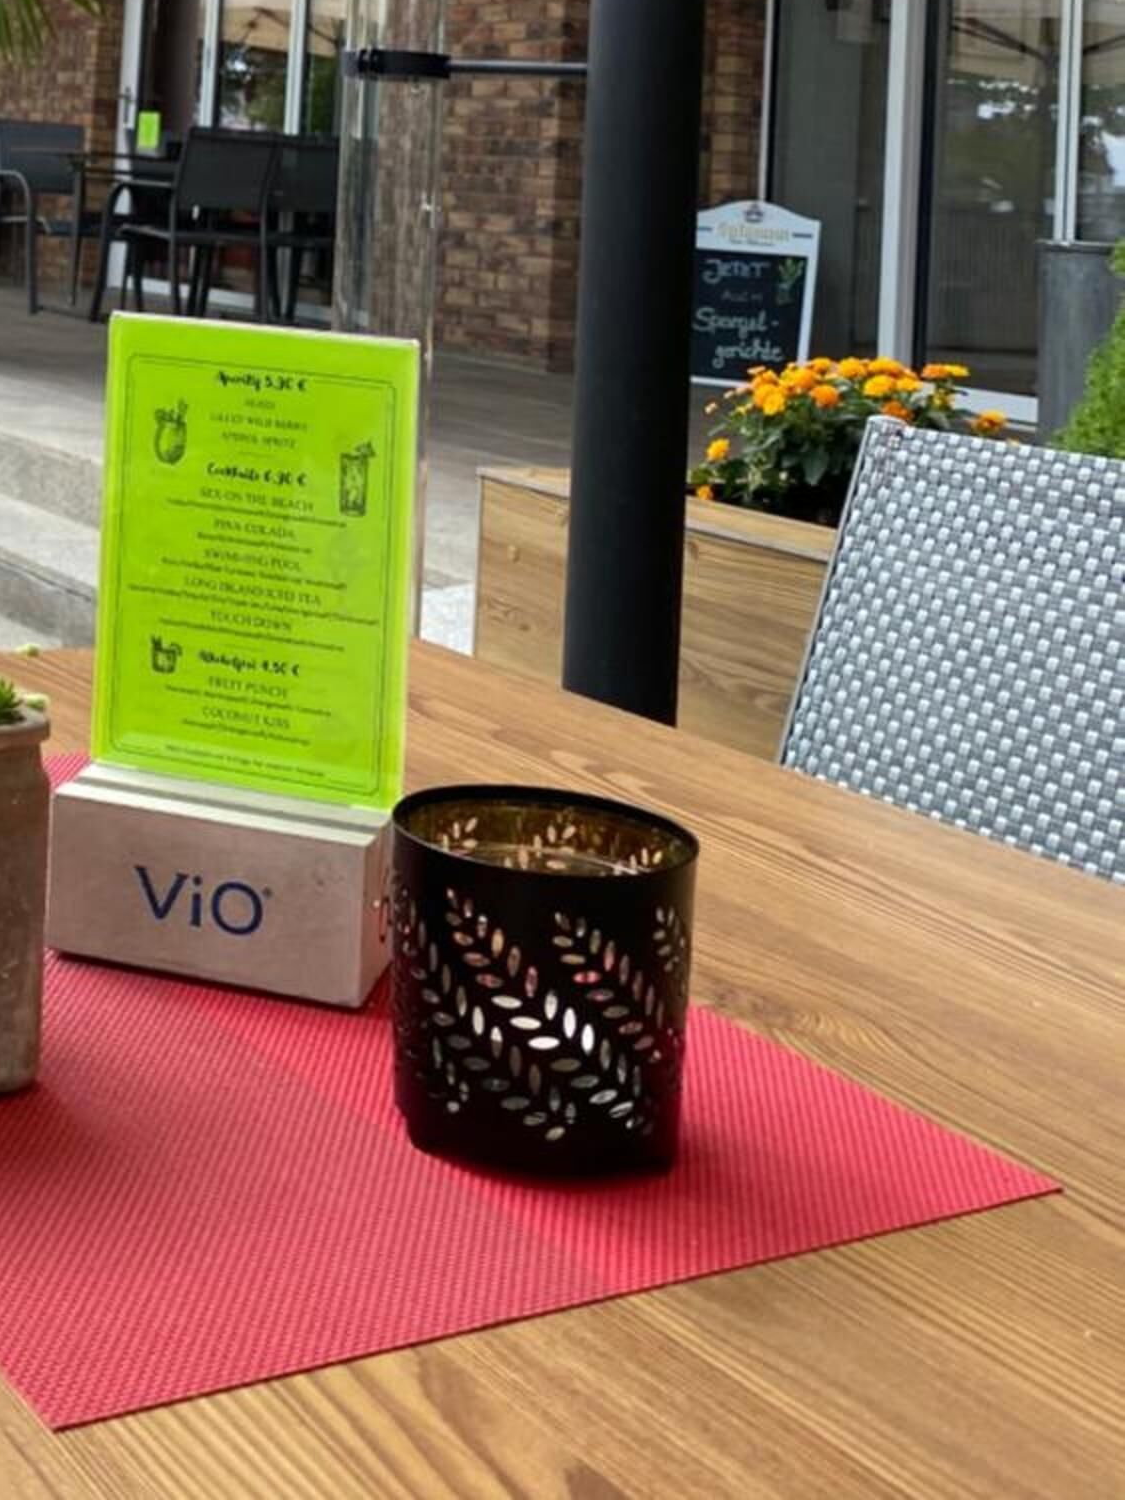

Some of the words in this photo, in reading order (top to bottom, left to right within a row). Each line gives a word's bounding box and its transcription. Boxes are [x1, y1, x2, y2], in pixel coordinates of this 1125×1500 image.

[712, 338, 784, 369] gerichte
[272, 498, 314, 512] BEACH
[183, 576, 218, 591] LONG
[134, 865, 264, 936] ViO
